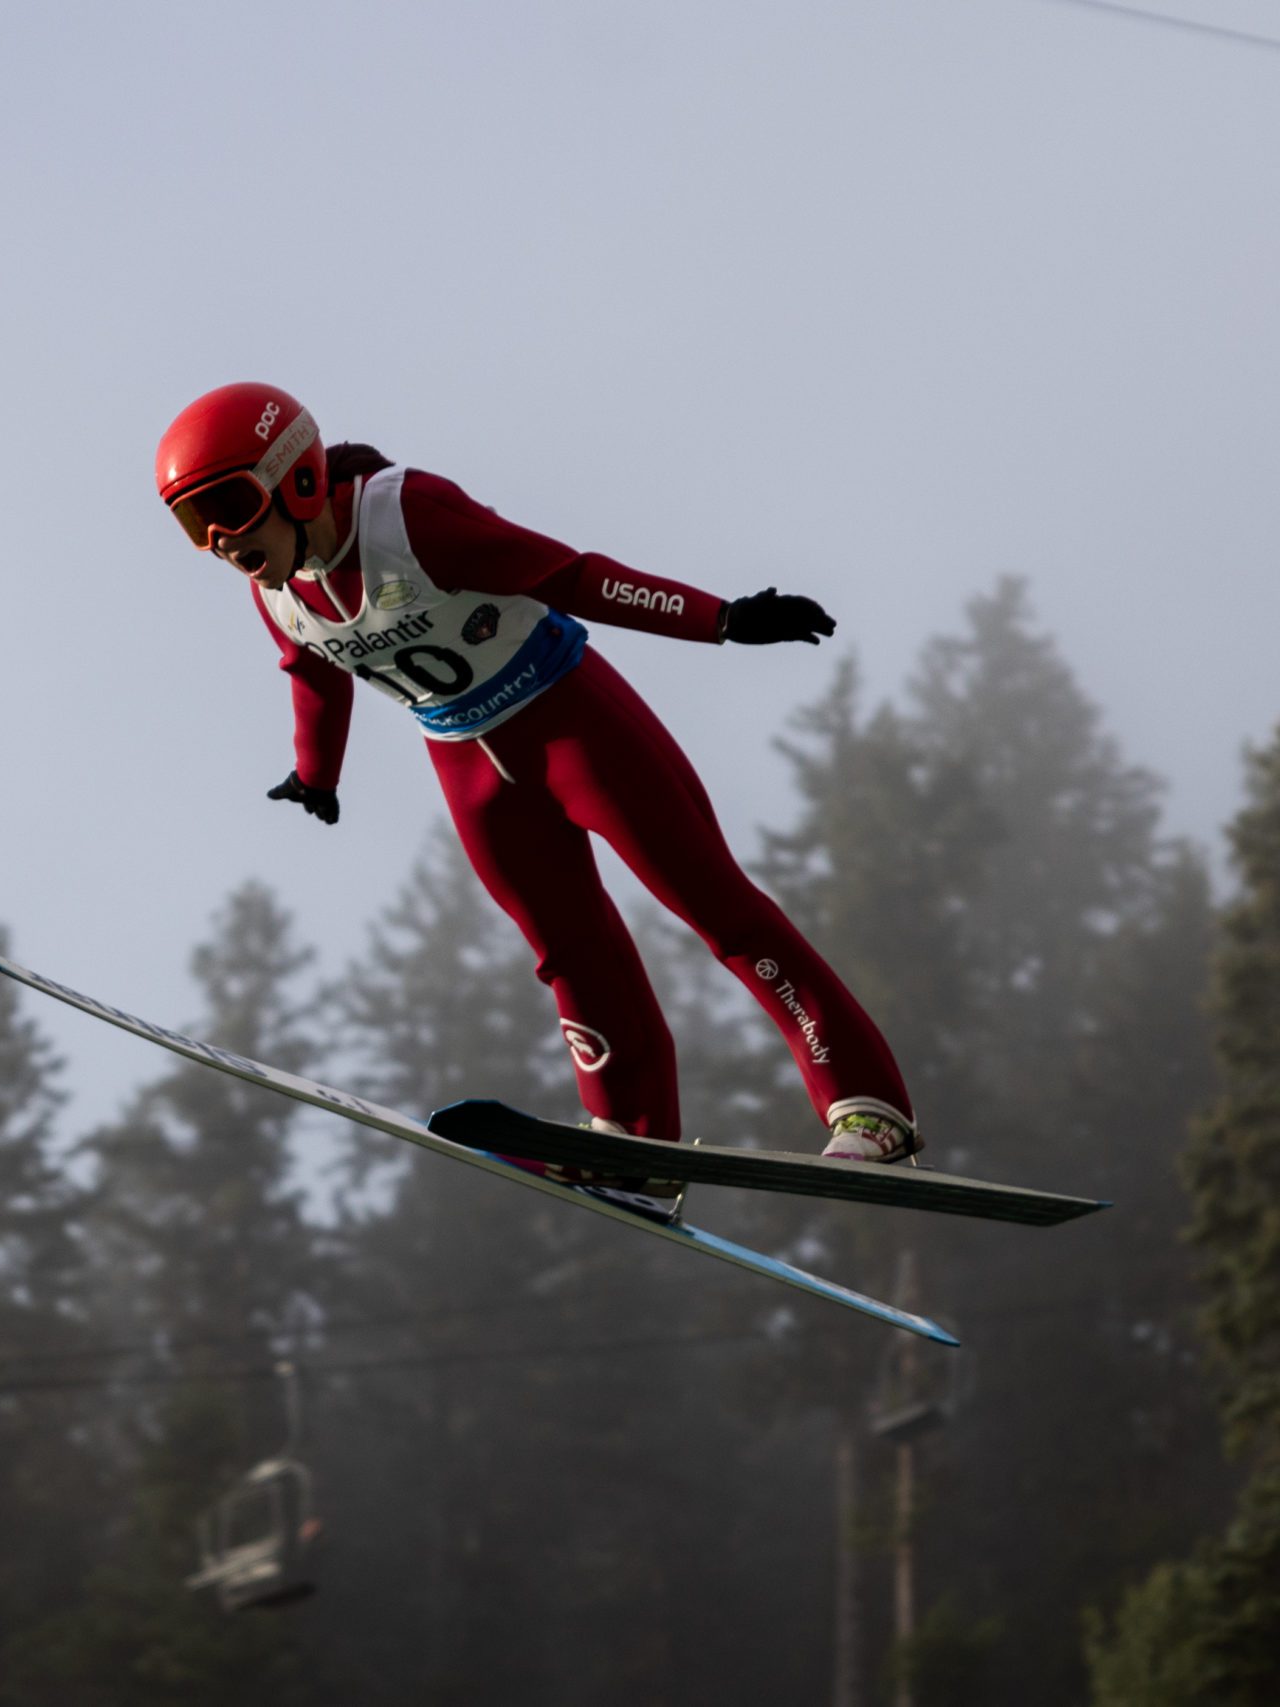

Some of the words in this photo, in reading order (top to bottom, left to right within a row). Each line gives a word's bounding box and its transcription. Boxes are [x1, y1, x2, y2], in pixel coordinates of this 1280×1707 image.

[255, 402, 280, 441] poc
[265, 427, 310, 478] SMITH
[601, 578, 685, 616] USANA
[323, 610, 435, 664] Palantir
[354, 645, 475, 704] 10
[775, 979, 830, 1064] Therabody
